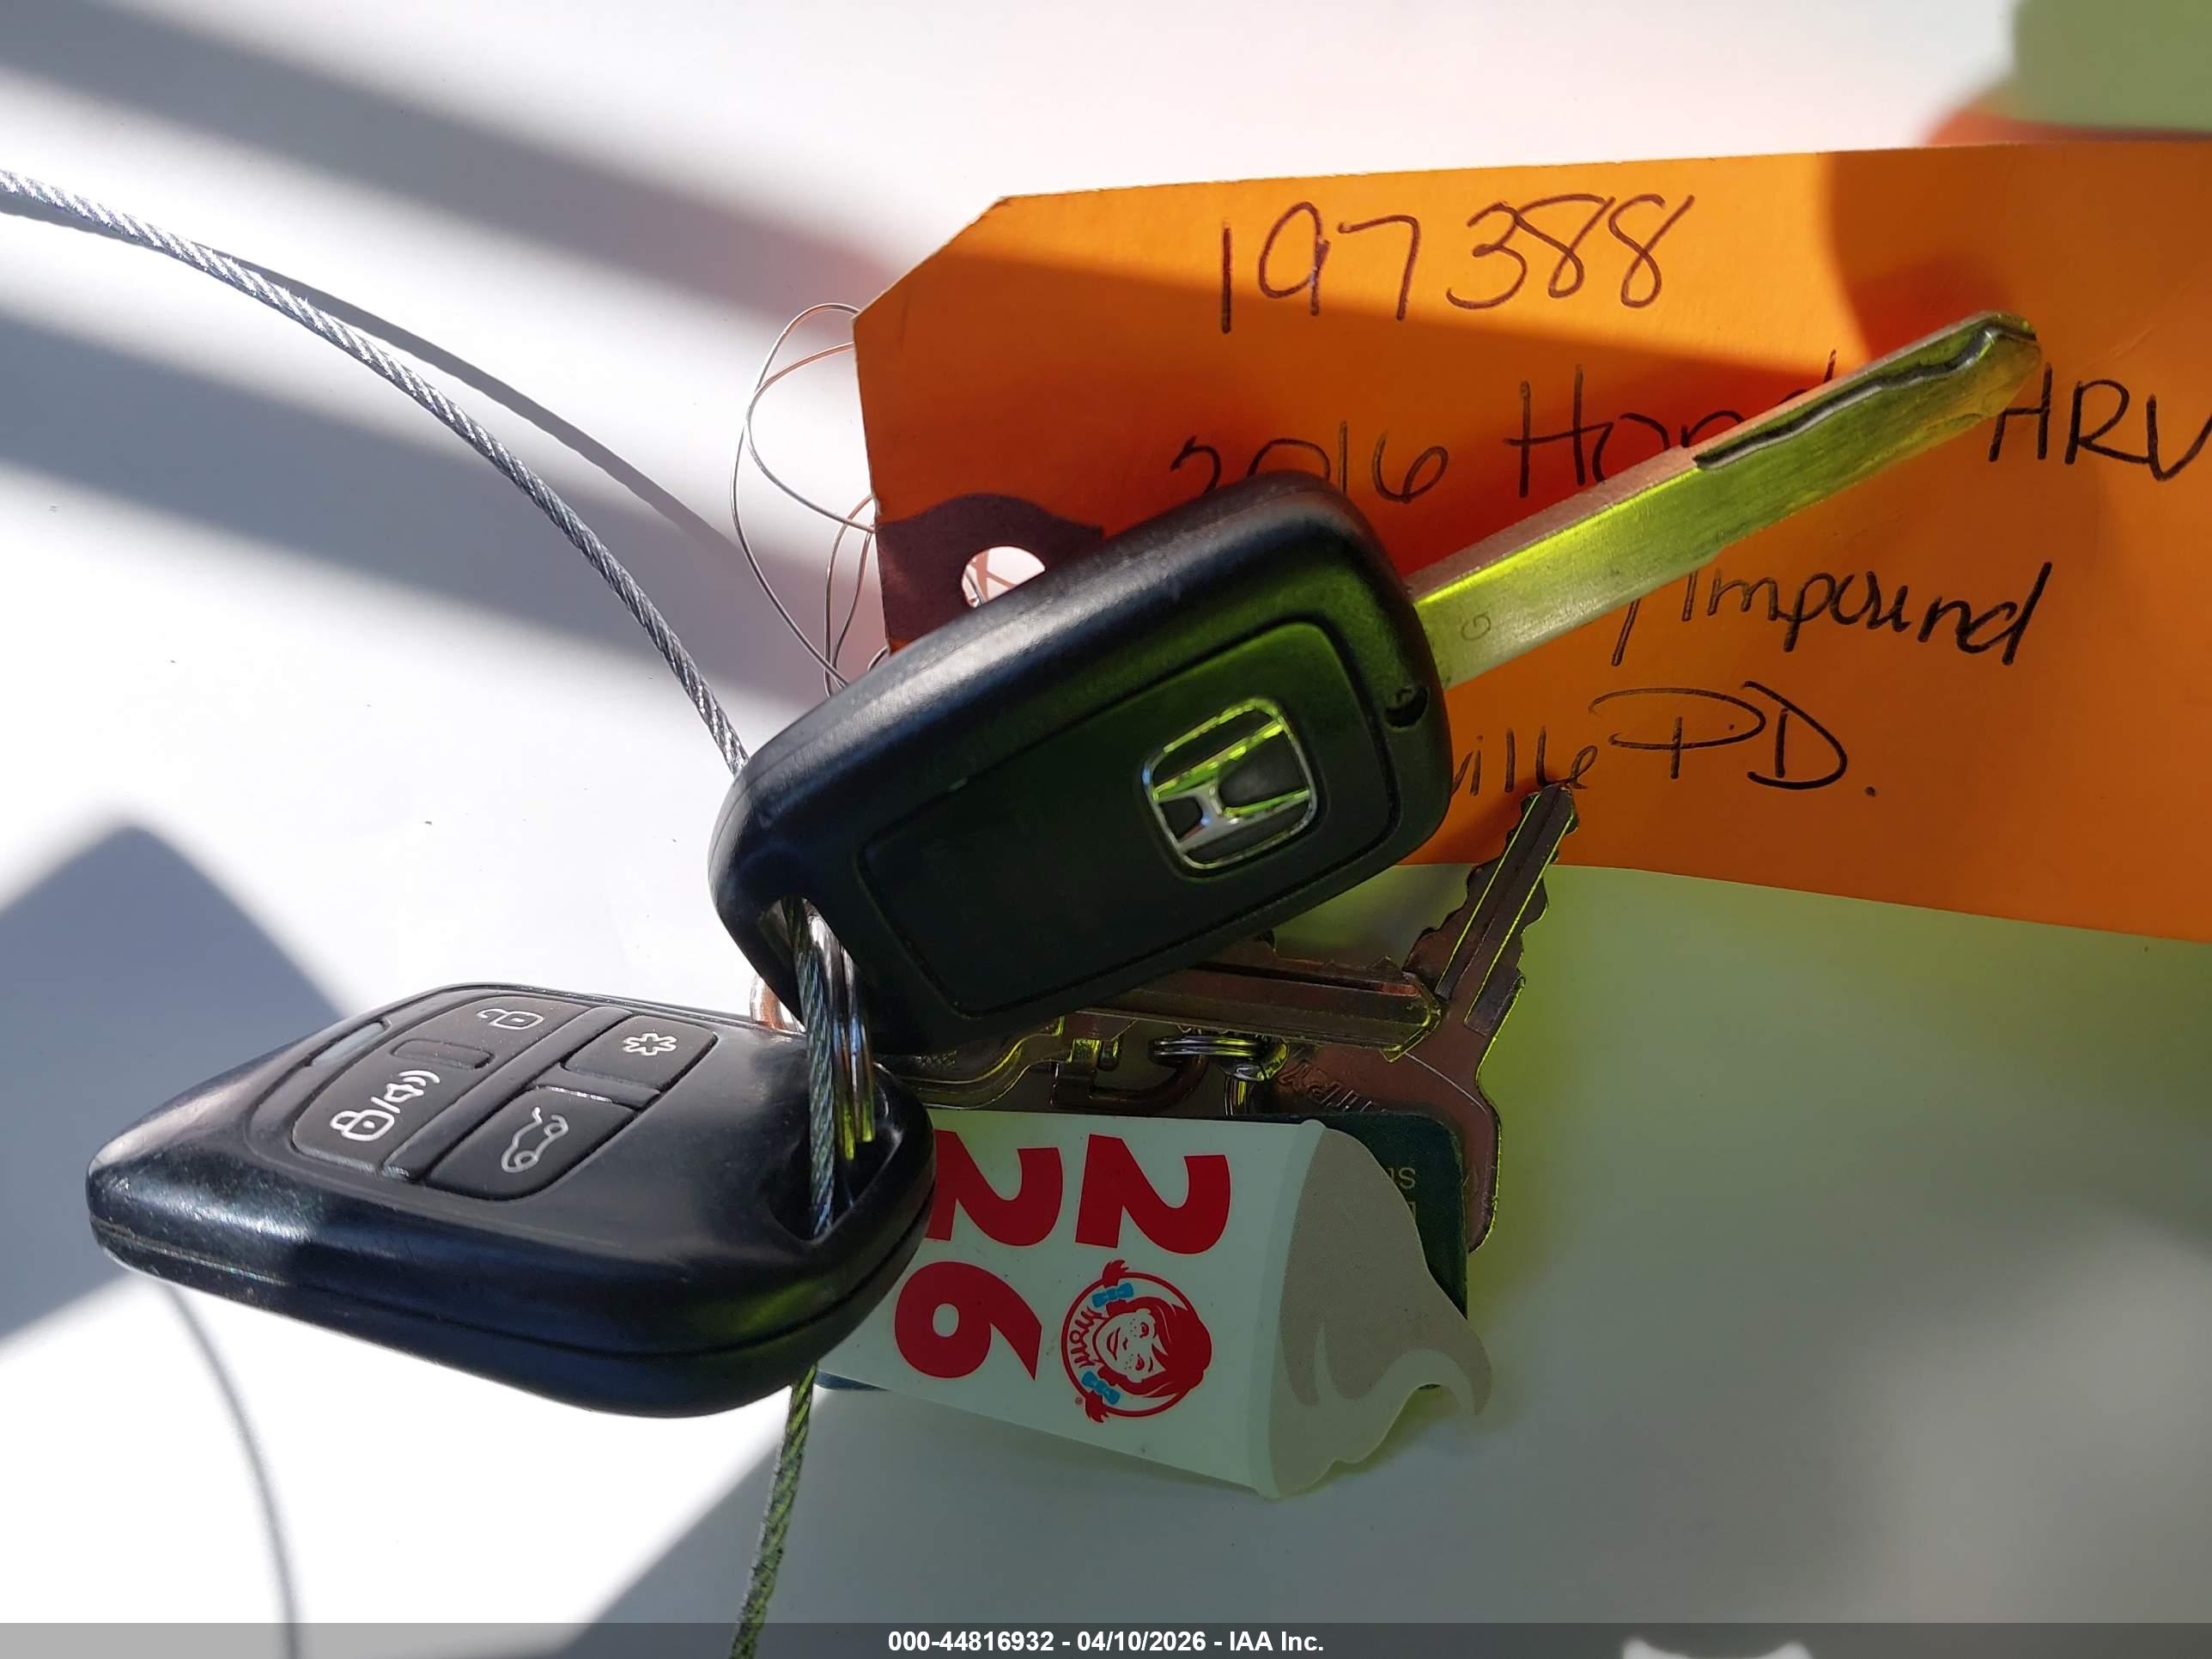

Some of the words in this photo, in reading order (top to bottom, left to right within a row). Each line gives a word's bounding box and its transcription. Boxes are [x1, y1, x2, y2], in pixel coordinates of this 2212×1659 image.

[1219, 192, 1695, 333] 197388
[1503, 348, 1838, 498] Hon
[1987, 361, 2212, 482] HRV
[1588, 680, 1877, 798] PD.
